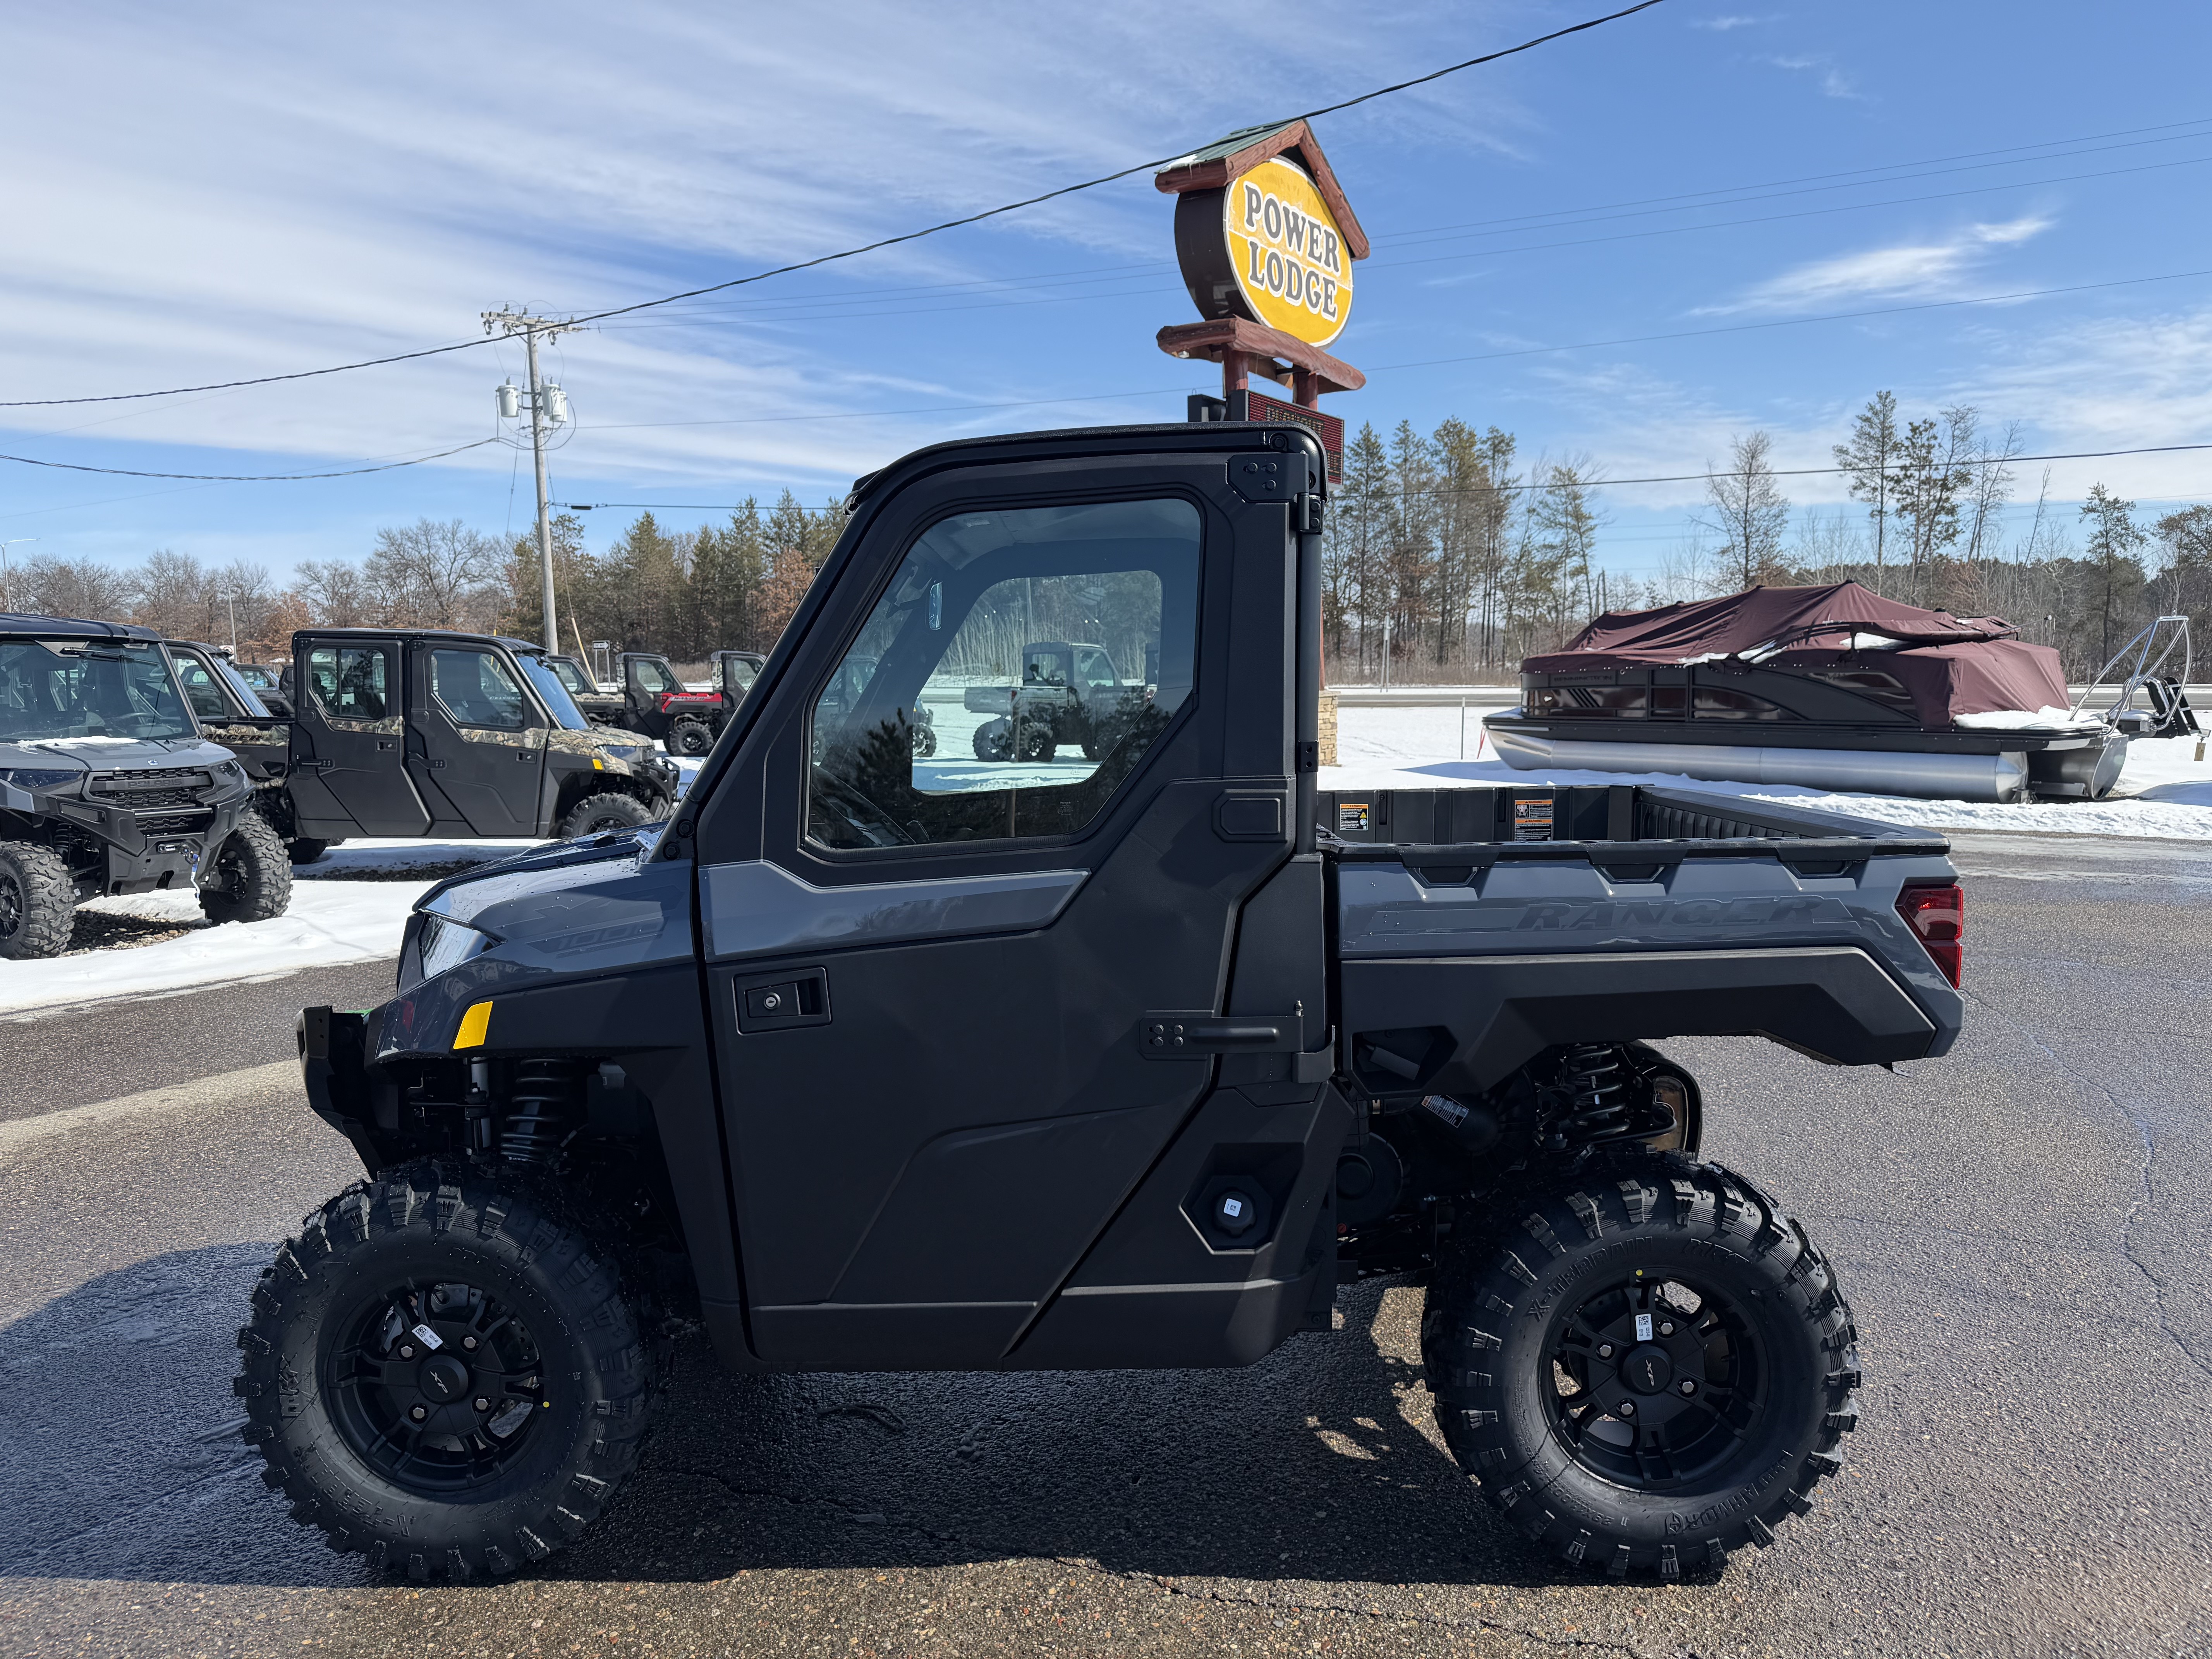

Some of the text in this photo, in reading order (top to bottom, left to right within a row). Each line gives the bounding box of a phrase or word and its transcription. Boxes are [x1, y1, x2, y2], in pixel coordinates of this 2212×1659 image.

[1244, 185, 1340, 273] POWER
[1249, 241, 1337, 319] LODGE
[127, 778, 182, 789] POLARIS
[1515, 895, 1823, 930] RANGER
[558, 921, 663, 949] 1000
[429, 1370, 448, 1394] XP
[1645, 1359, 1655, 1386] XP
[1685, 1482, 1759, 1529] ARMOR
